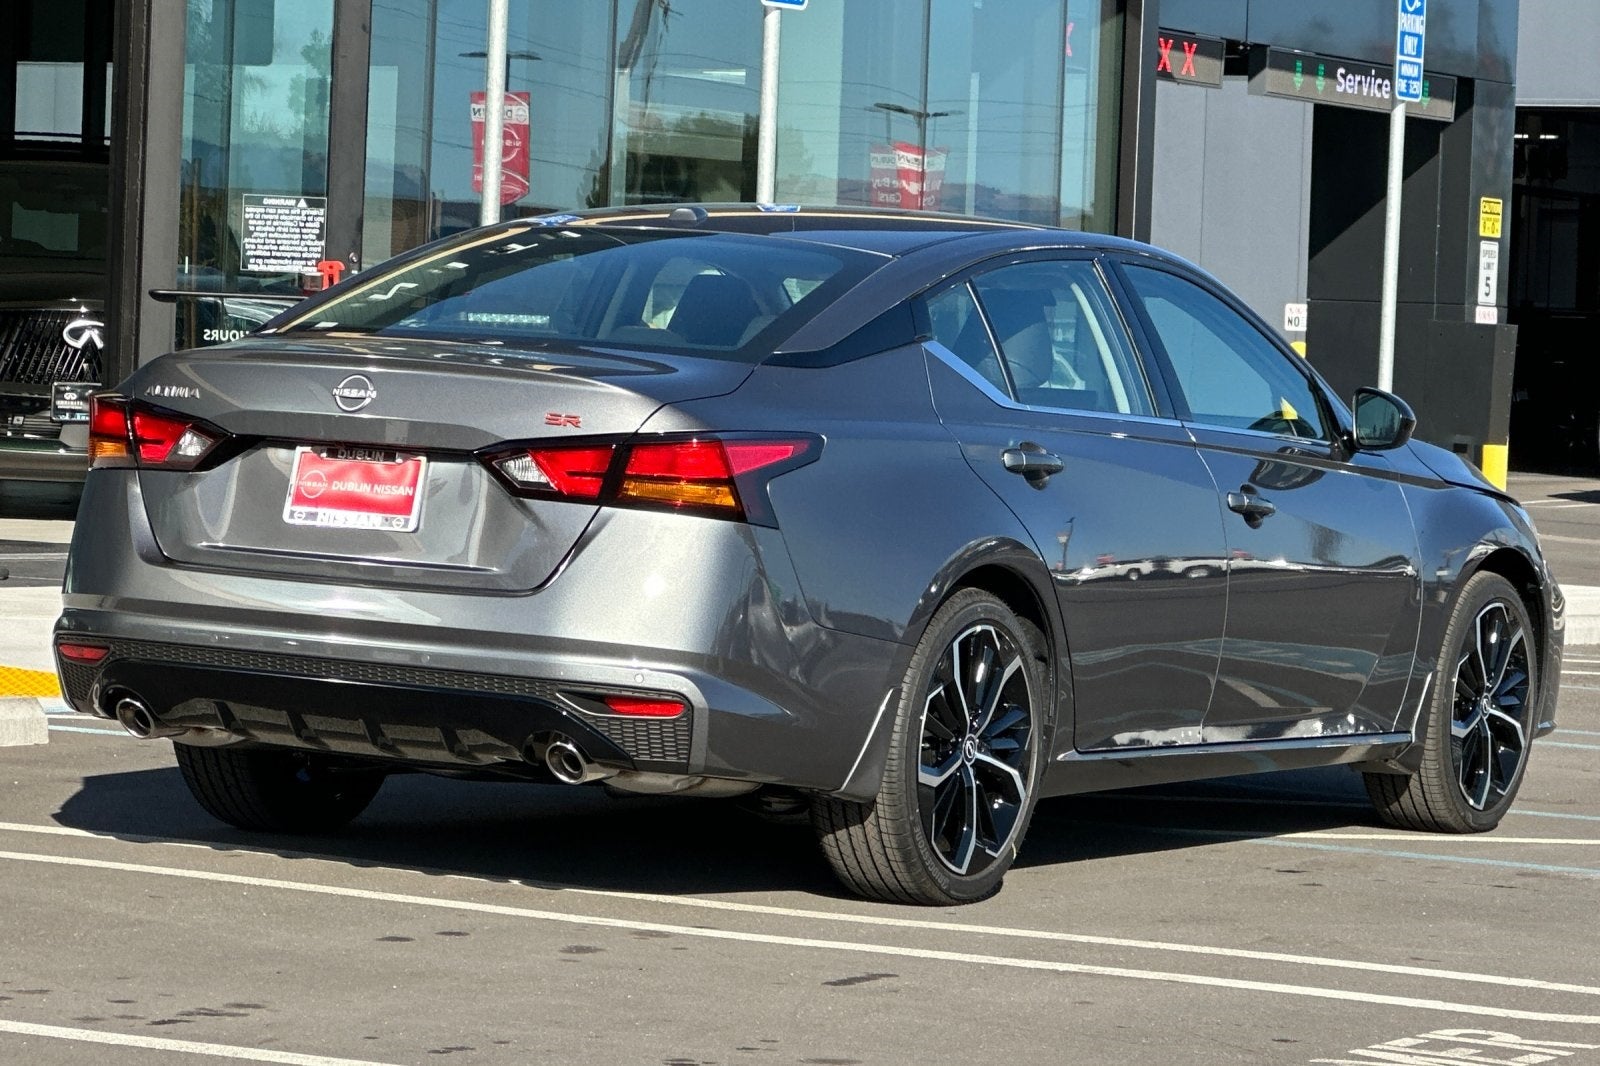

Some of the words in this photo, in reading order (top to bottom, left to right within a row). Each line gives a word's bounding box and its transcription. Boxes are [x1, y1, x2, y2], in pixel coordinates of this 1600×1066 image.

[1400, 12, 1424, 35] PARKING
[1404, 35, 1418, 55] ONLY
[1336, 67, 1391, 99] Service
[1482, 249, 1496, 258] SPEED
[1484, 262, 1495, 270] LIMIT
[1484, 276, 1491, 297] 5
[1287, 316, 1300, 327] NO
[143, 384, 200, 399] ALTIMA
[332, 387, 377, 399] NISSAN
[545, 413, 582, 428] SR
[337, 449, 384, 462] DUBLIN
[332, 481, 371, 492] DUBLIN
[374, 483, 414, 496] NISSAN
[317, 511, 381, 527] NISSAN
